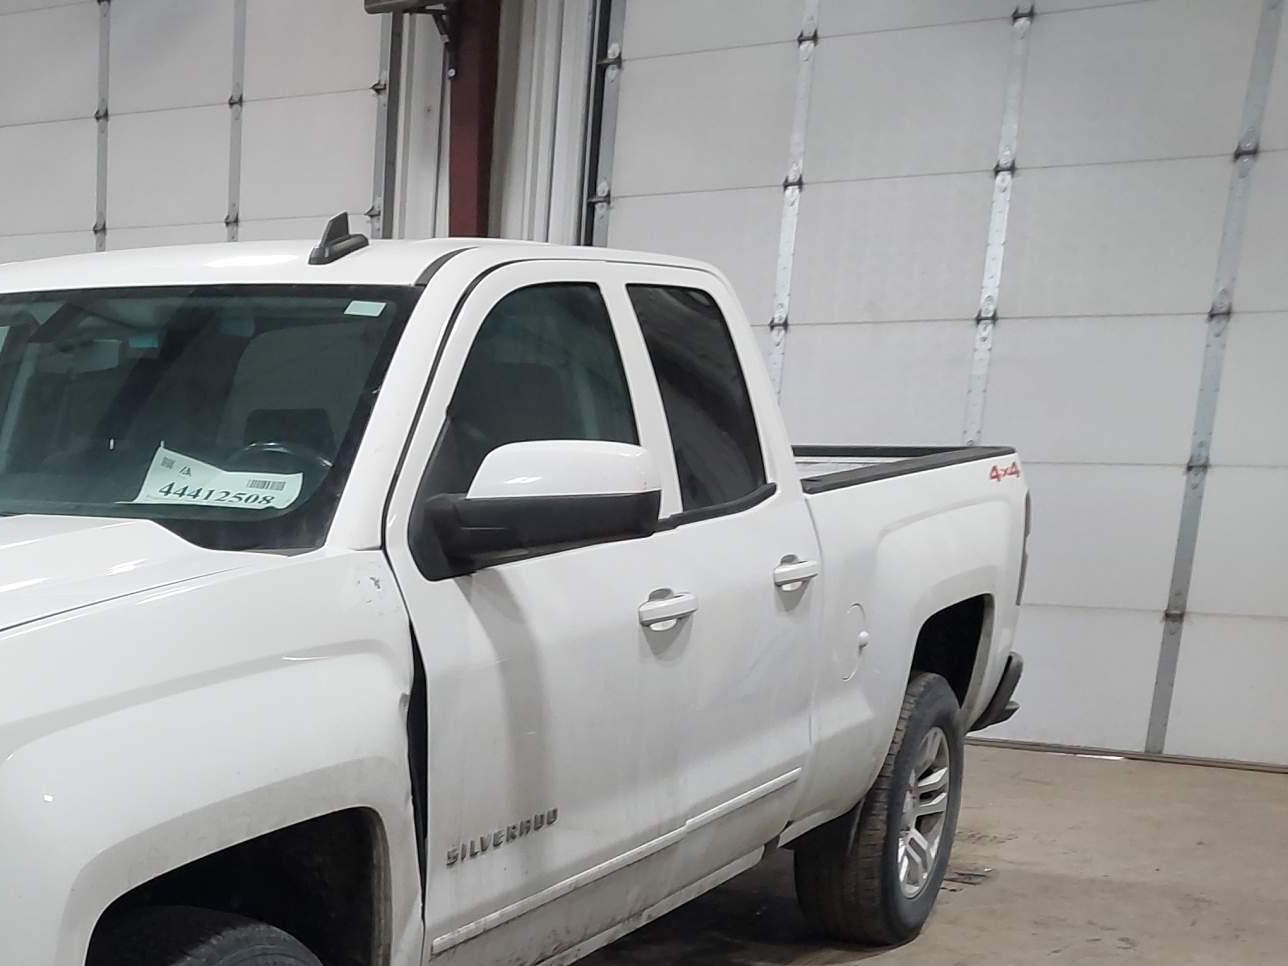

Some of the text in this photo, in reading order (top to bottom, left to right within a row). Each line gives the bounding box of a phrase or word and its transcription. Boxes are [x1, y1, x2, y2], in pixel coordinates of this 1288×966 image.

[990, 461, 1020, 482] 4x4
[158, 481, 275, 505] 44412508
[446, 808, 558, 867] SILVERADO
